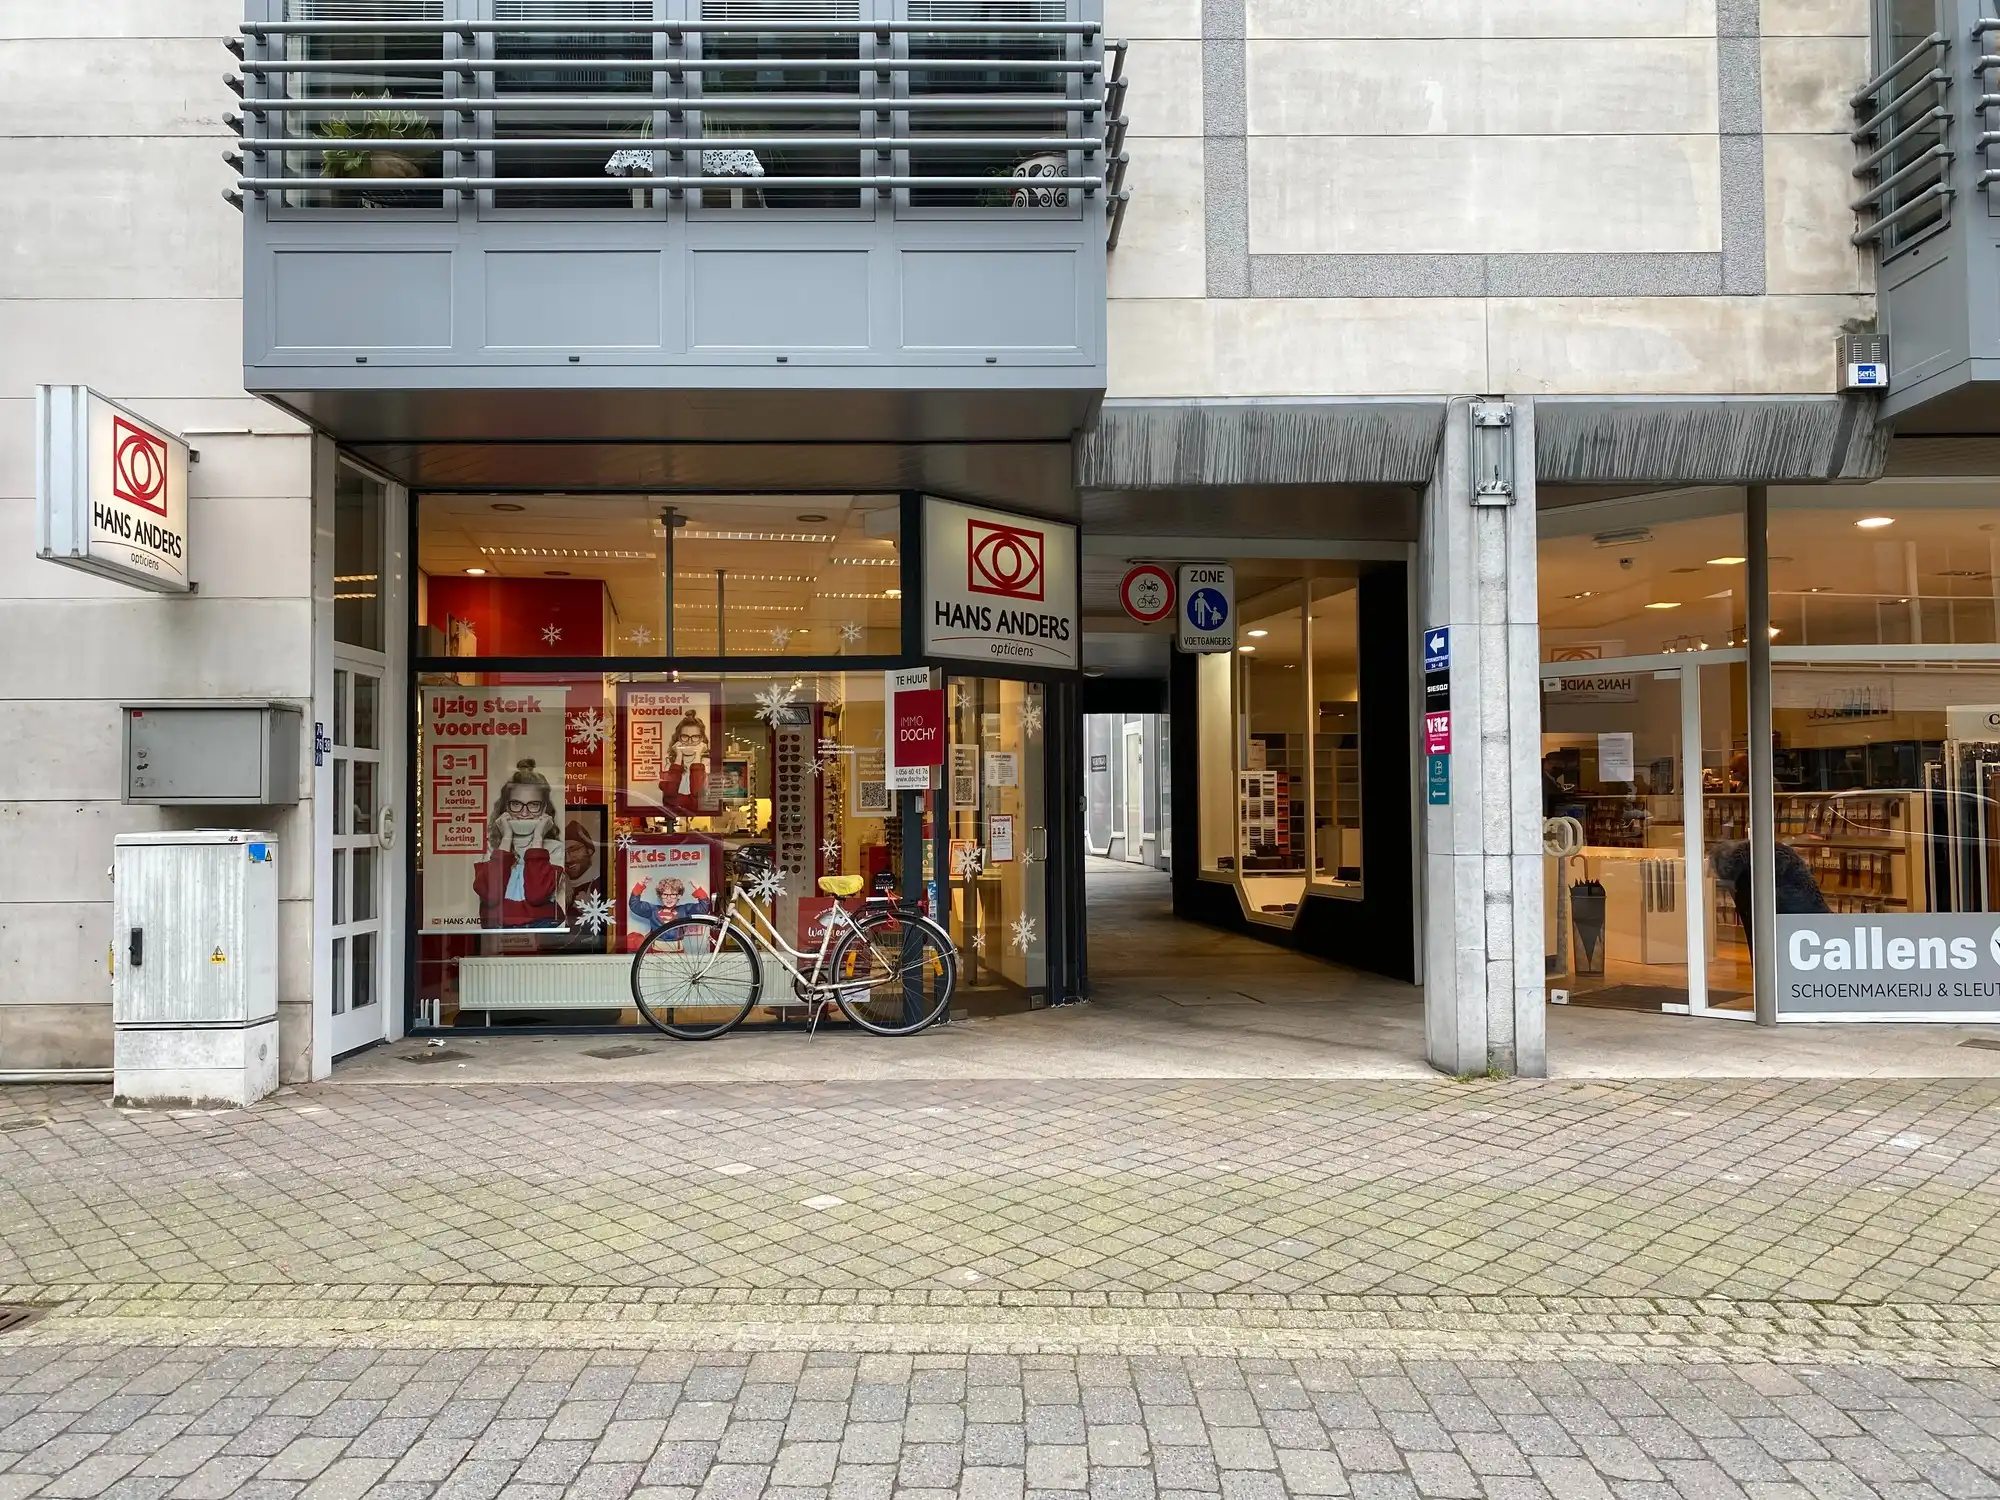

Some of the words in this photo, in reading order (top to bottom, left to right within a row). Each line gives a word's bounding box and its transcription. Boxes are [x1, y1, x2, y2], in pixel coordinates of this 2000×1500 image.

[94, 501, 132, 539] HANS
[134, 519, 182, 559] ANDERS
[130, 552, 160, 571] opticiens
[1190, 570, 1224, 583] ZONE
[936, 600, 992, 632] HANS
[996, 610, 1070, 641] ANDERS
[1184, 636, 1231, 646] VOETGANGERS
[990, 641, 1034, 658] opticiens
[896, 676, 904, 686] TE
[907, 674, 928, 684] HUUR
[631, 694, 656, 706] IJzig
[658, 694, 689, 704] sterk
[433, 695, 478, 718] IJzig
[484, 695, 542, 713] sterk
[632, 706, 682, 716] voordeel
[433, 718, 528, 735] voordeel
[901, 716, 923, 727] IMMO
[637, 727, 656, 736] 3=1
[901, 728, 936, 741] DOCHY
[573, 746, 588, 755] het
[443, 754, 477, 770] 3=1
[456, 776, 466, 784] of
[576, 784, 587, 792] En
[445, 797, 475, 805] korting
[574, 796, 588, 805] Uit
[445, 834, 475, 843] korting
[630, 849, 666, 863] Kids
[1789, 927, 1978, 971] Callens
[1792, 983, 1932, 998] SCHOENMAKERIJ
[1938, 983, 1948, 997] &
